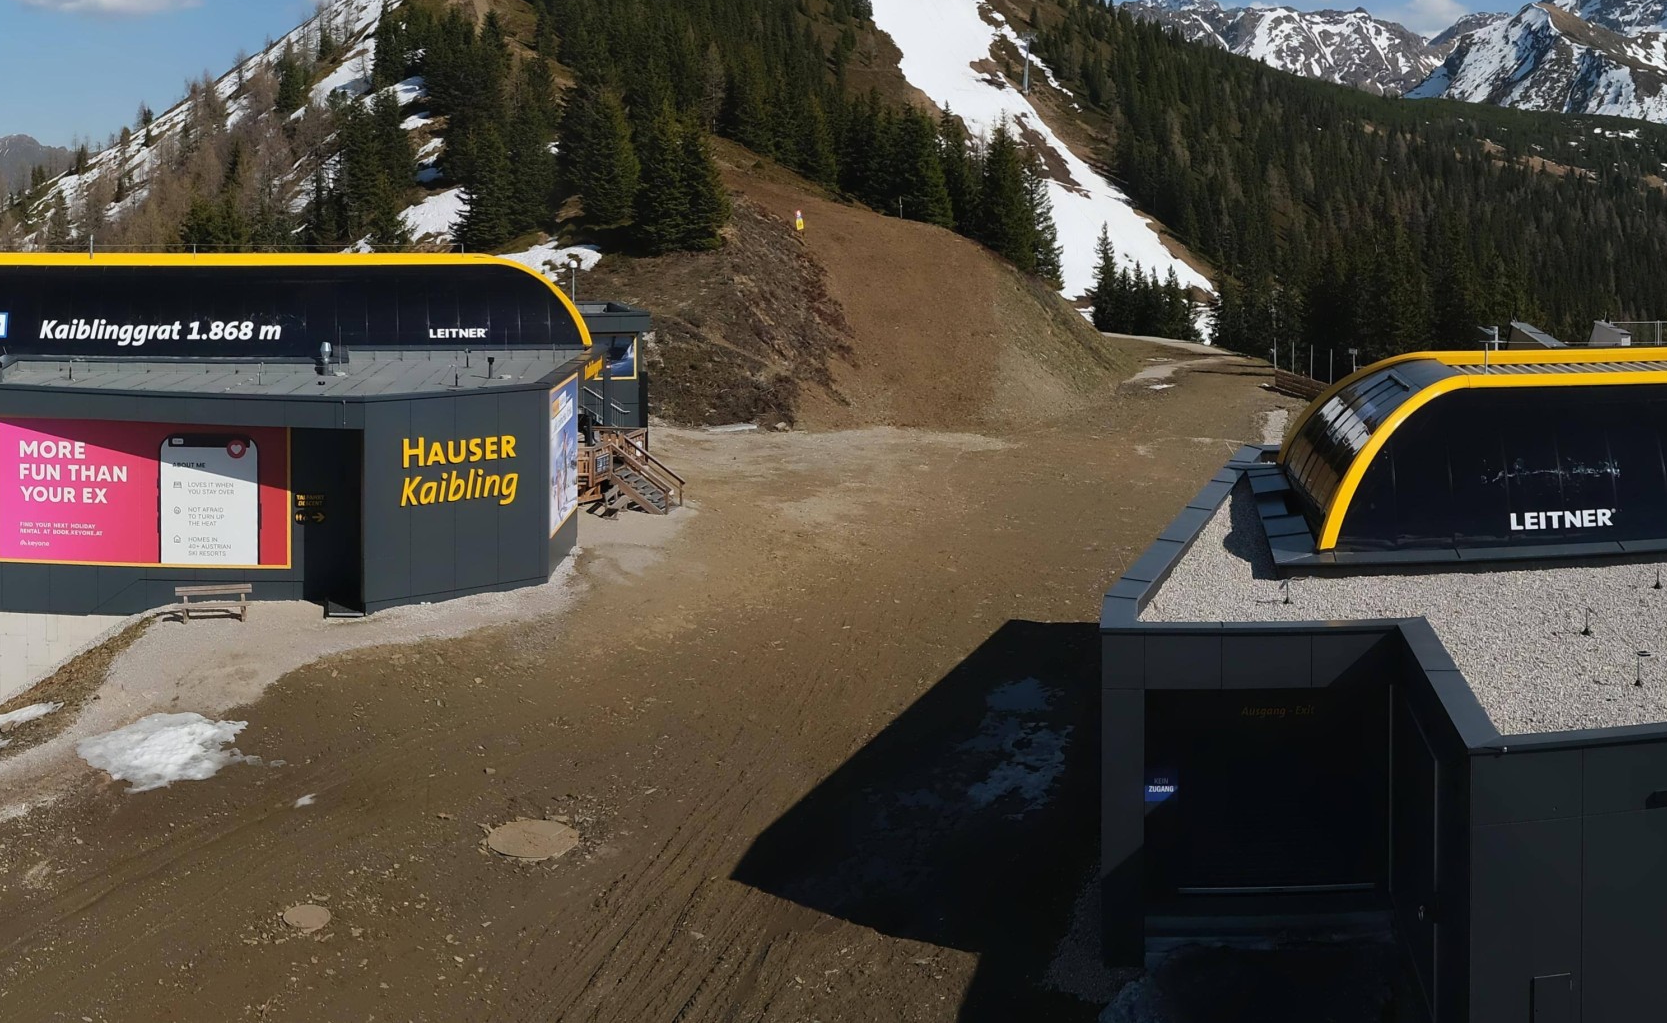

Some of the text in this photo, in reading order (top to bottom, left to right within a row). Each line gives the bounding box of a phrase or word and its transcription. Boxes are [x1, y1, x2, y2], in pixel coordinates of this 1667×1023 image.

[39, 319, 281, 347] Kaiblinggrat 1.868 m
[19, 440, 86, 459] MORE
[402, 435, 517, 468] HAUSER
[19, 463, 128, 482] FUN THAN
[20, 485, 108, 504] YOUR EX
[400, 468, 519, 507] Kaibling
[1241, 706, 1287, 719] Ausgang
[1295, 705, 1316, 715] Exit
[1148, 785, 1174, 793] ZUGANG
